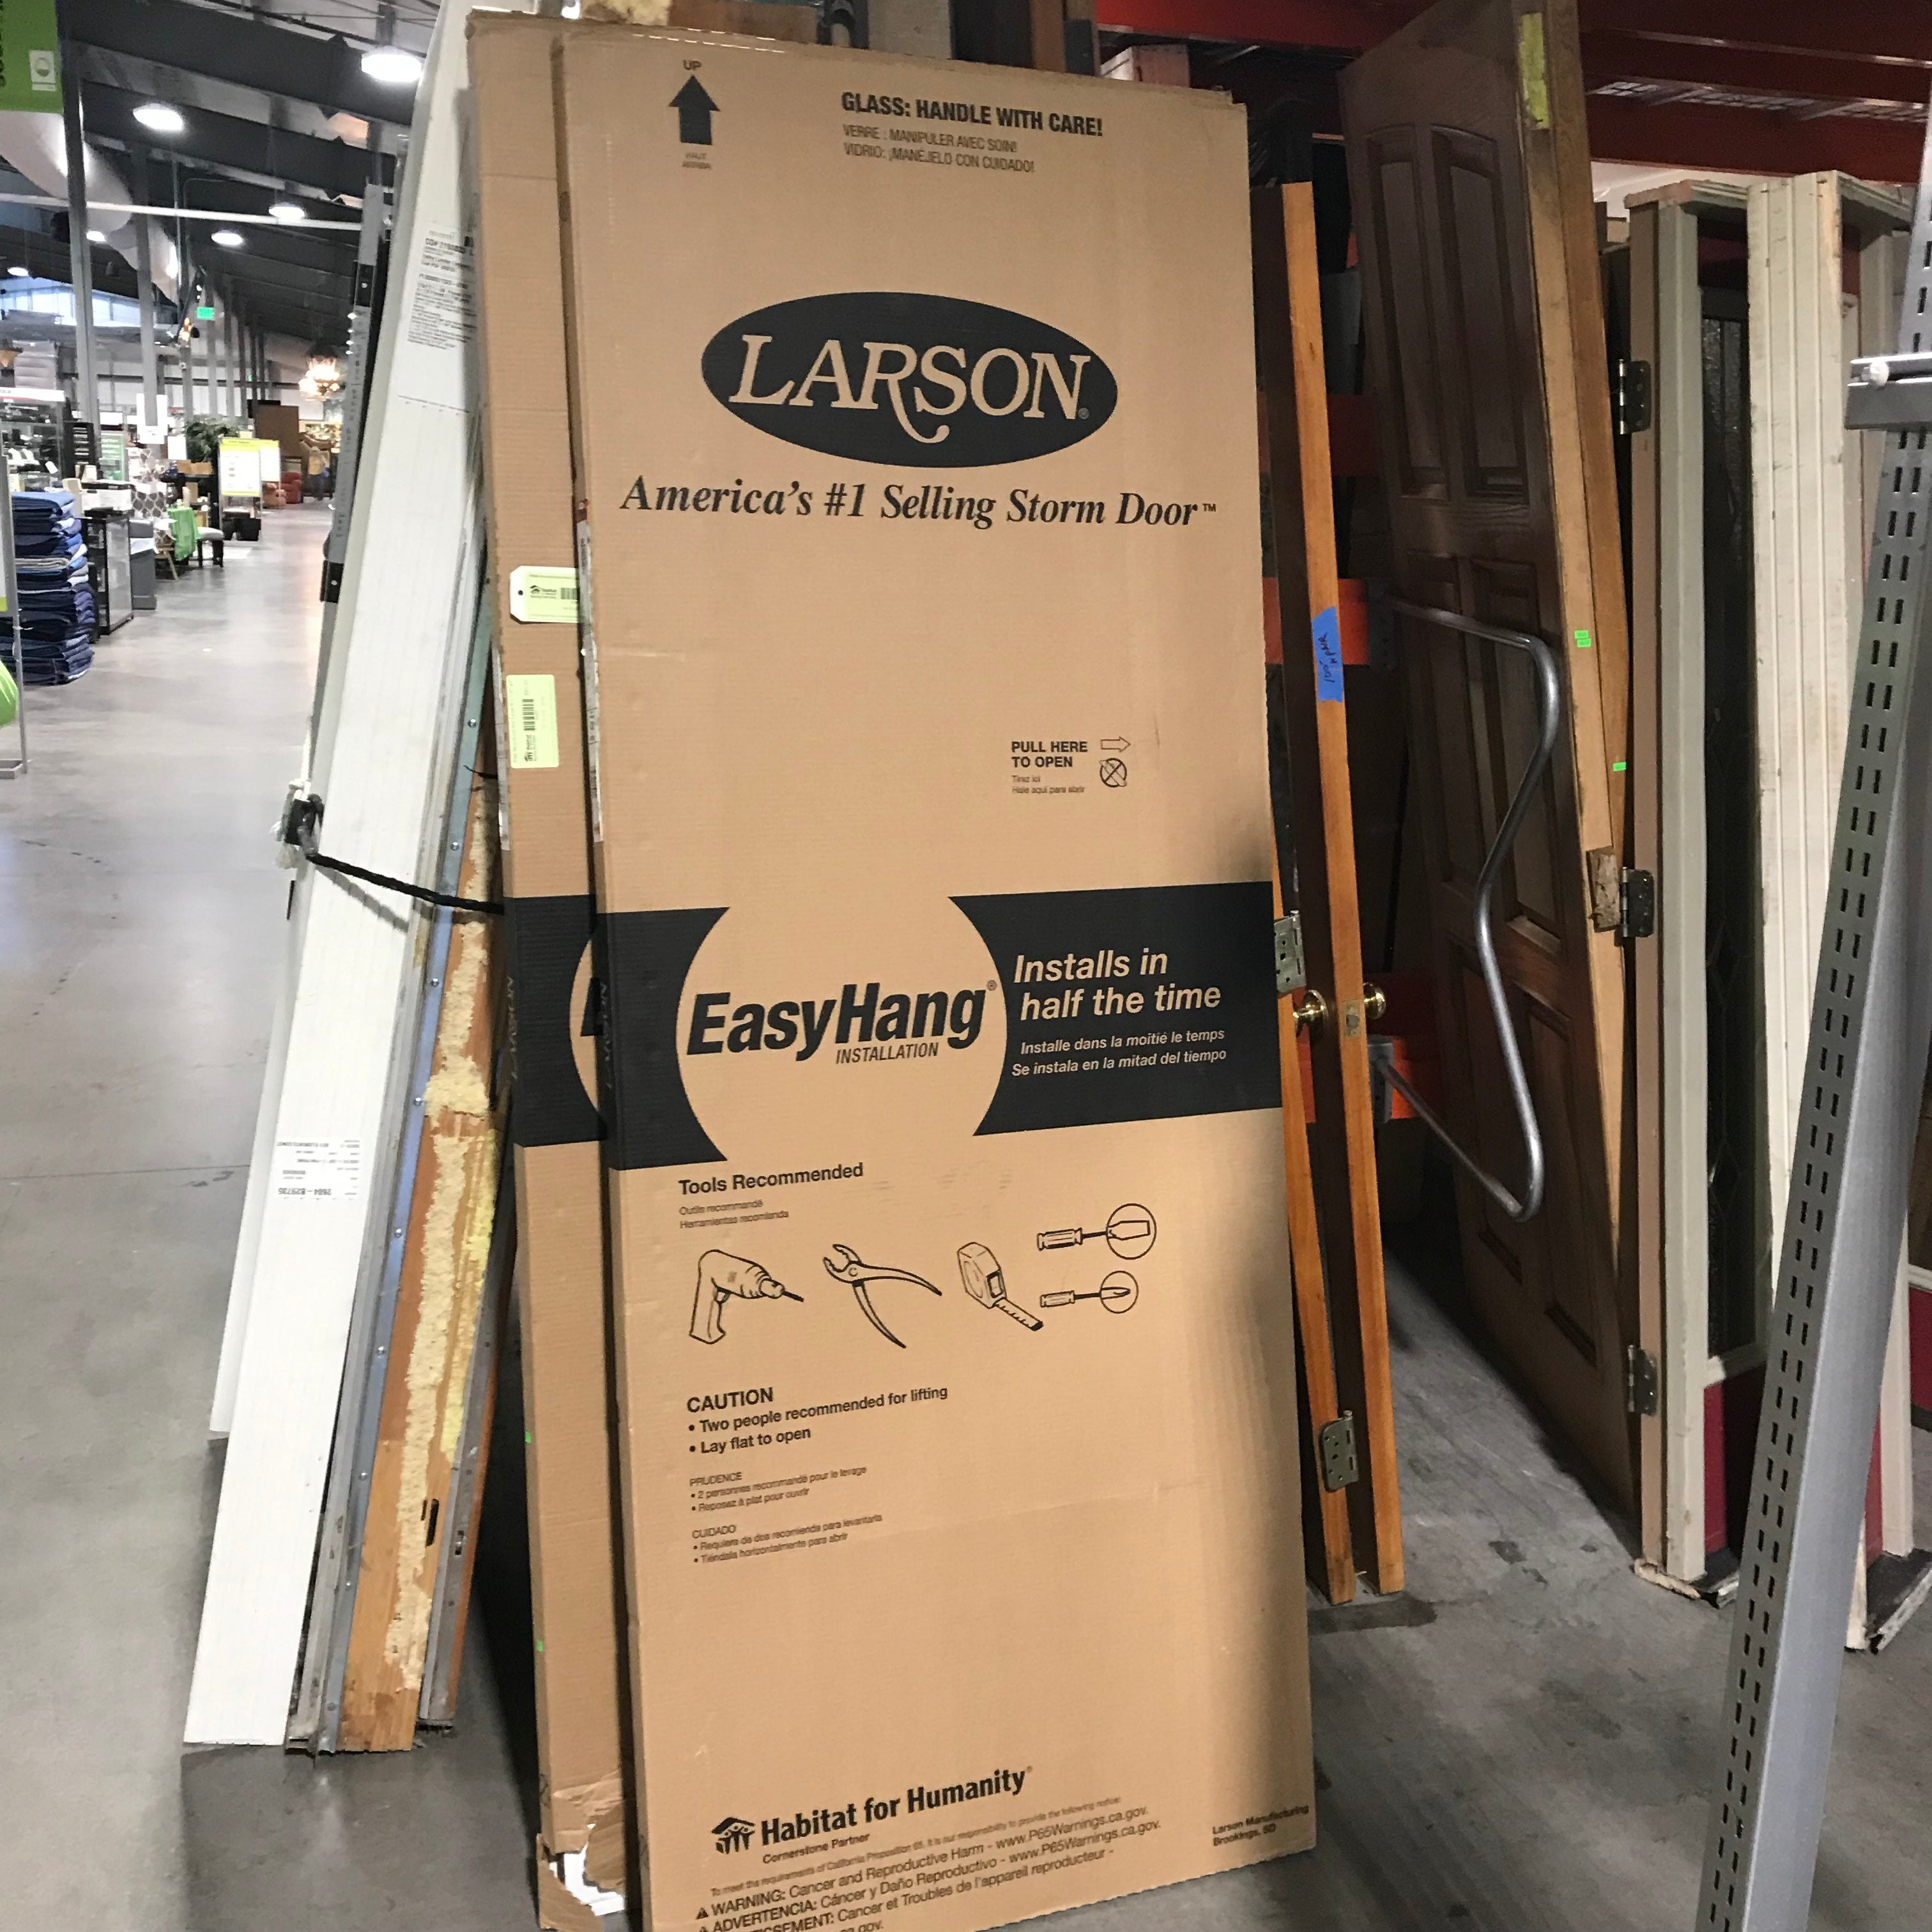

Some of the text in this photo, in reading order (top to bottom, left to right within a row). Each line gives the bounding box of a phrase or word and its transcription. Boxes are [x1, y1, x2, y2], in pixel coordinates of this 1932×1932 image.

[683, 59, 702, 71] UP
[841, 91, 1103, 137] GLASS: HANDLE WITH CARE!
[889, 128, 954, 147] MANIPULER
[956, 135, 985, 151] AVEC
[956, 153, 979, 167] CON
[728, 334, 1091, 444] LARSON
[620, 475, 813, 516] America's
[824, 484, 866, 518] #1
[880, 484, 997, 530] Selling
[1006, 488, 1106, 525] Storm
[1011, 741, 1089, 753] PULL HERE
[1011, 756, 1073, 768] TO OPEN
[1013, 947, 1168, 984] Installs in
[1020, 981, 1222, 1022] half the time
[686, 982, 986, 1063] EasyHang
[835, 1041, 940, 1065] INSTALLATION
[1020, 1028, 1225, 1055] Installe dans la moitié le temps
[1011, 1048, 1227, 1077] Se instala en la mitad del tiempo
[678, 1162, 864, 1195] Tools Recommended
[687, 1386, 773, 1413] CAUTION
[700, 1385, 949, 1433] Two people recommended for lifting
[701, 1427, 812, 1455] Lay flat to open
[689, 1471, 742, 1487] PRUDENCE
[761, 1767, 1026, 1846] Habitat for Humanity
[1213, 1821, 1244, 1835] Larson
[763, 1833, 870, 1864] Cornerstone Partner
[711, 1889, 786, 1915] WARNING:
[789, 1878, 836, 1898] Cancer
[839, 1869, 862, 1887] and
[866, 1853, 949, 1880] Reproductive
[951, 1844, 984, 1860] Harm
[713, 1899, 818, 1932] ADVERTENCIA:
[820, 1889, 866, 1909] Cáncer
[869, 1886, 878, 1900] y
[880, 1877, 914, 1894] Daño
[916, 1858, 998, 1885] Reproductivo
[837, 1901, 884, 1922] Cancer
[886, 1896, 899, 1910] et
[901, 1885, 954, 1906] Troubles
[956, 1880, 972, 1893] de
[974, 1866, 1029, 1888] l'appareil
[1030, 1848, 1107, 1876] reproducteur
